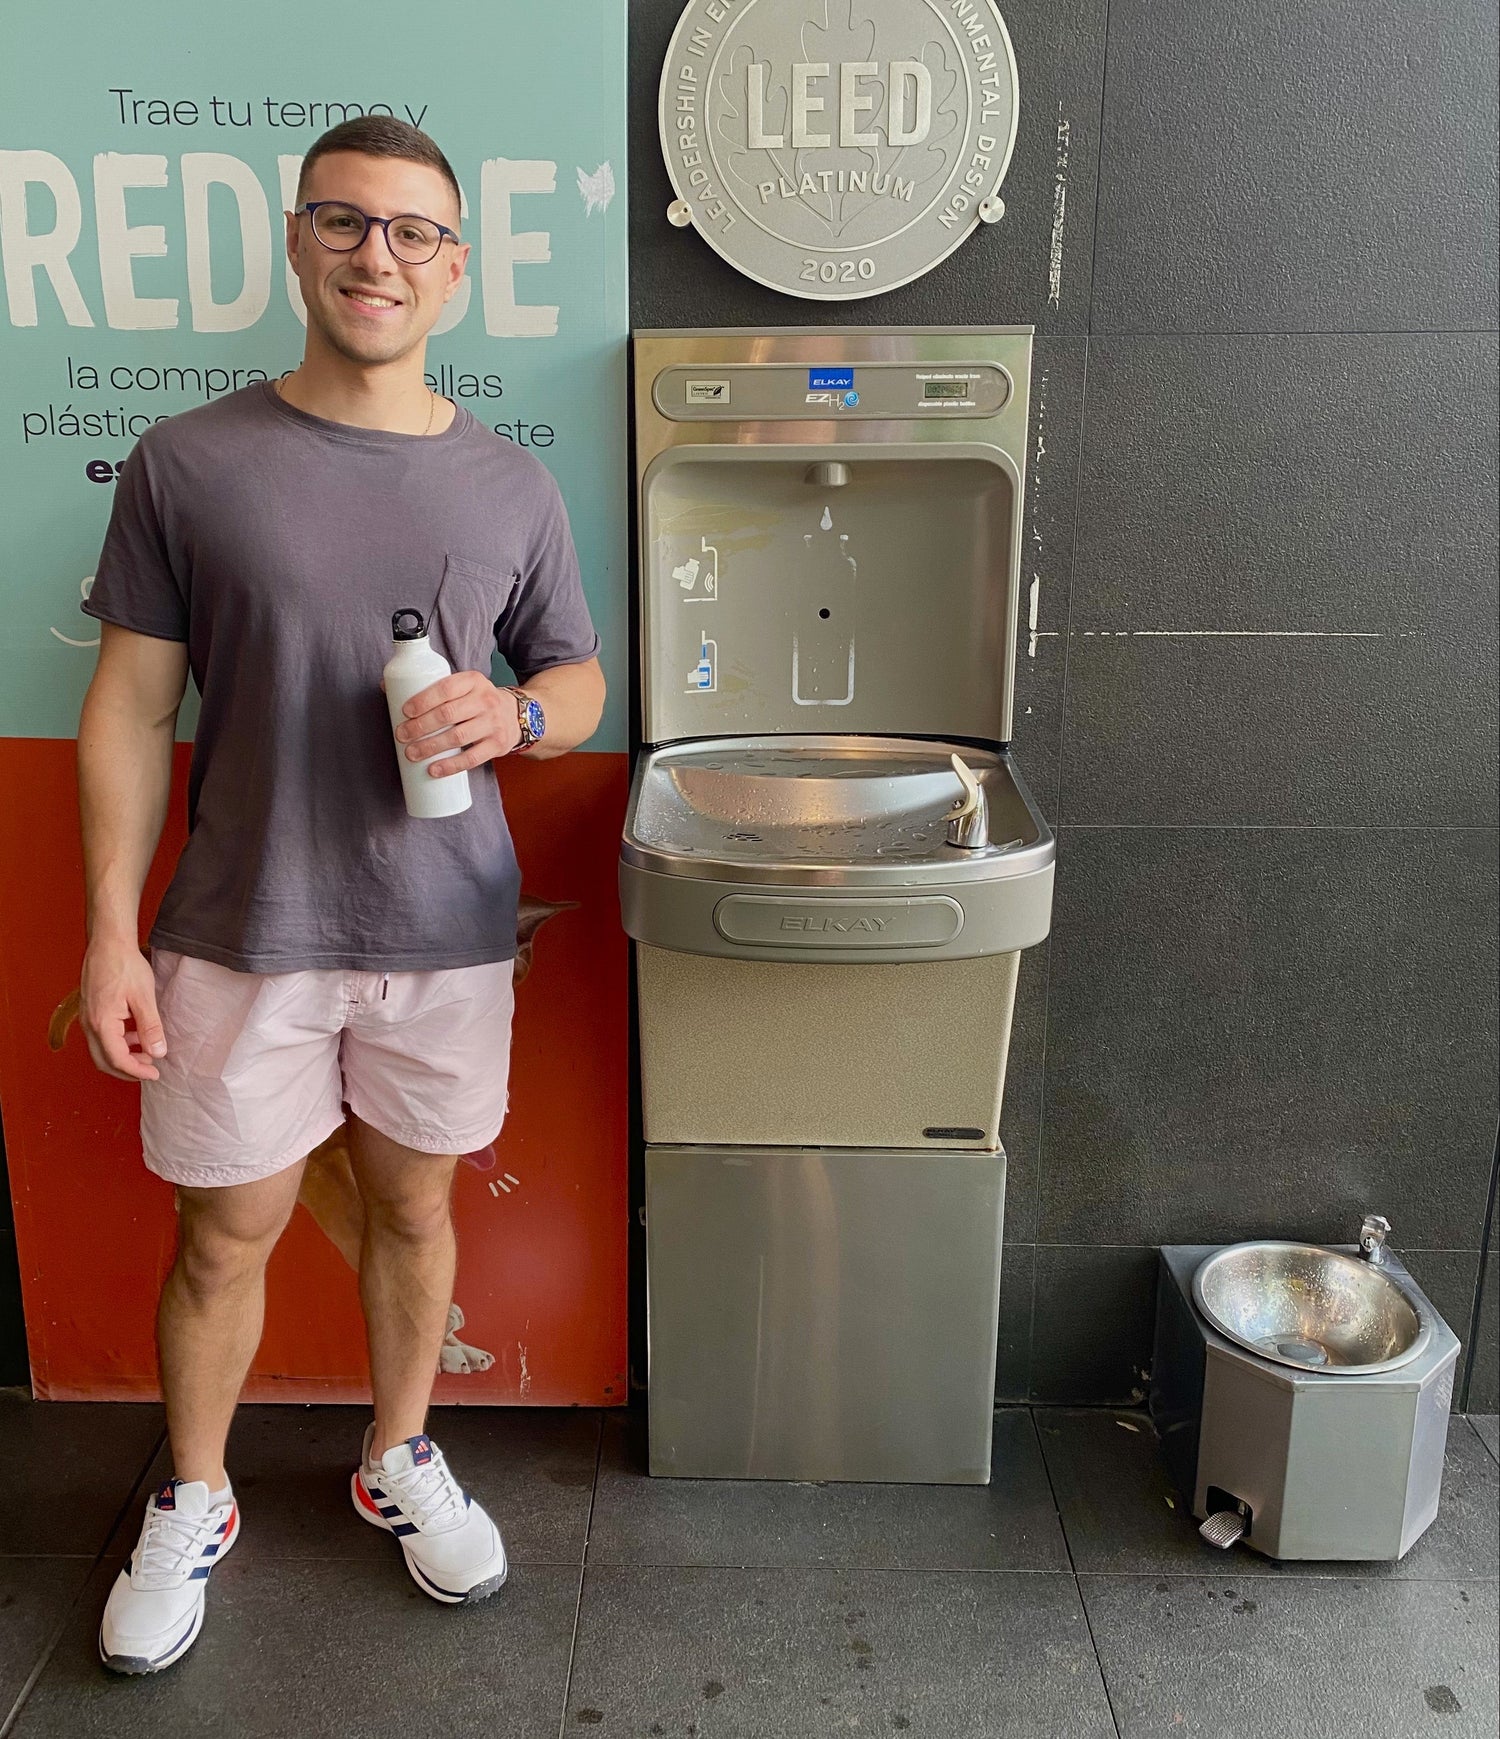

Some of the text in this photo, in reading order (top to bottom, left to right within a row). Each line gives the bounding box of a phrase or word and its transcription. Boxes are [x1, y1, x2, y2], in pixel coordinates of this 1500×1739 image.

[687, 26, 713, 57] IN
[108, 88, 200, 126] Trae
[209, 95, 253, 127] tu
[746, 61, 933, 149] LEED
[937, 0, 1001, 229] NMENTAL DESIGN
[676, 64, 737, 234] LEADERSHIP
[757, 170, 917, 204] PLATINUM
[799, 257, 876, 283] 2020
[67, 356, 100, 389] la
[424, 364, 503, 398] ellas
[812, 378, 851, 386] ELKAY
[22, 403, 555, 447] plástic ste
[780, 916, 894, 932] ELKAY
